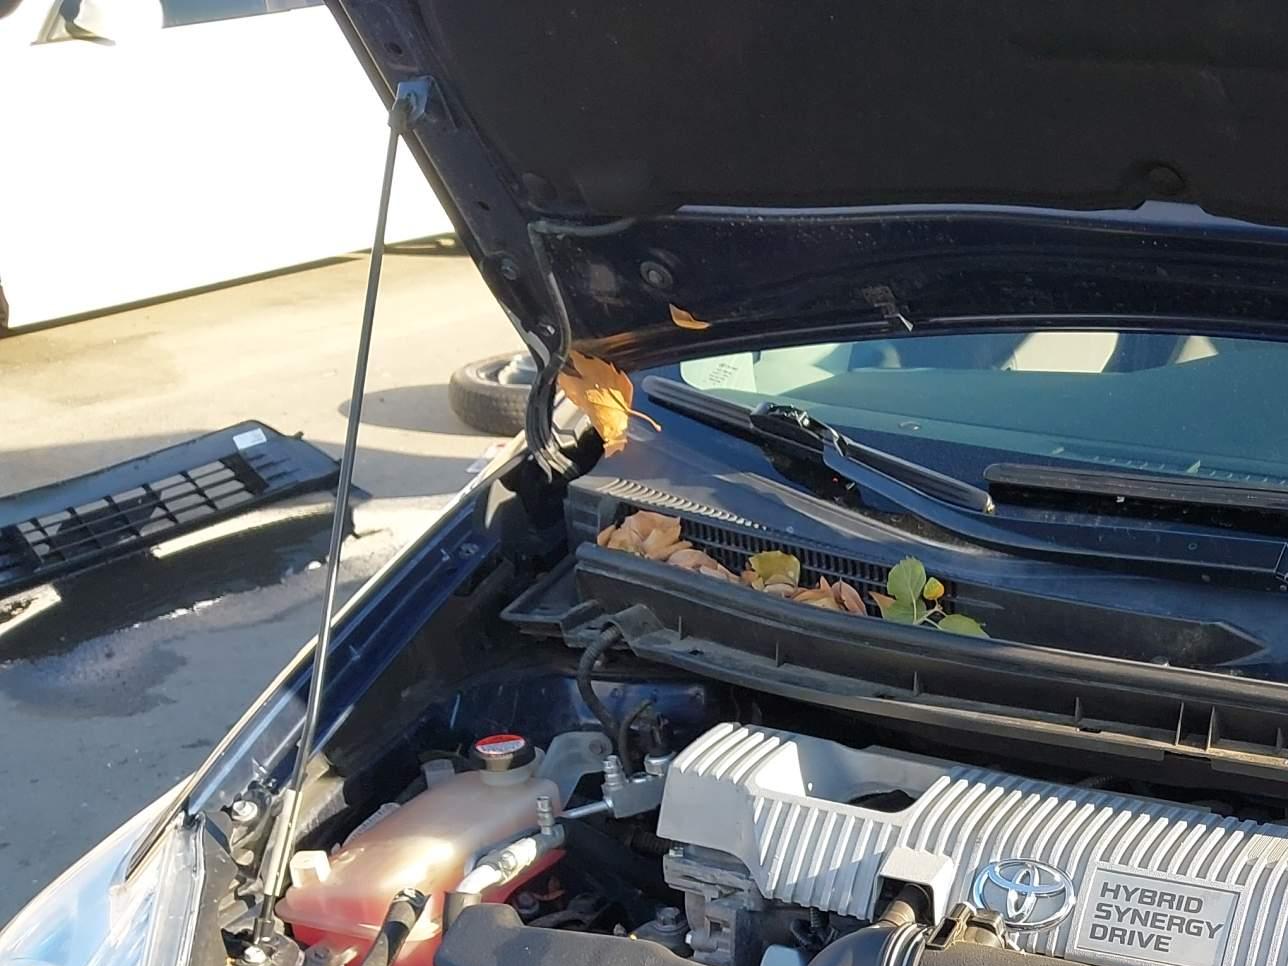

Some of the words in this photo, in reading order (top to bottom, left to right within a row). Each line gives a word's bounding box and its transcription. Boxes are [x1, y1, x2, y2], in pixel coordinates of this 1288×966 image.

[1100, 882, 1203, 914] HYBRID
[1094, 902, 1224, 939] SYNERGY
[1089, 923, 1172, 953] DRIVE
